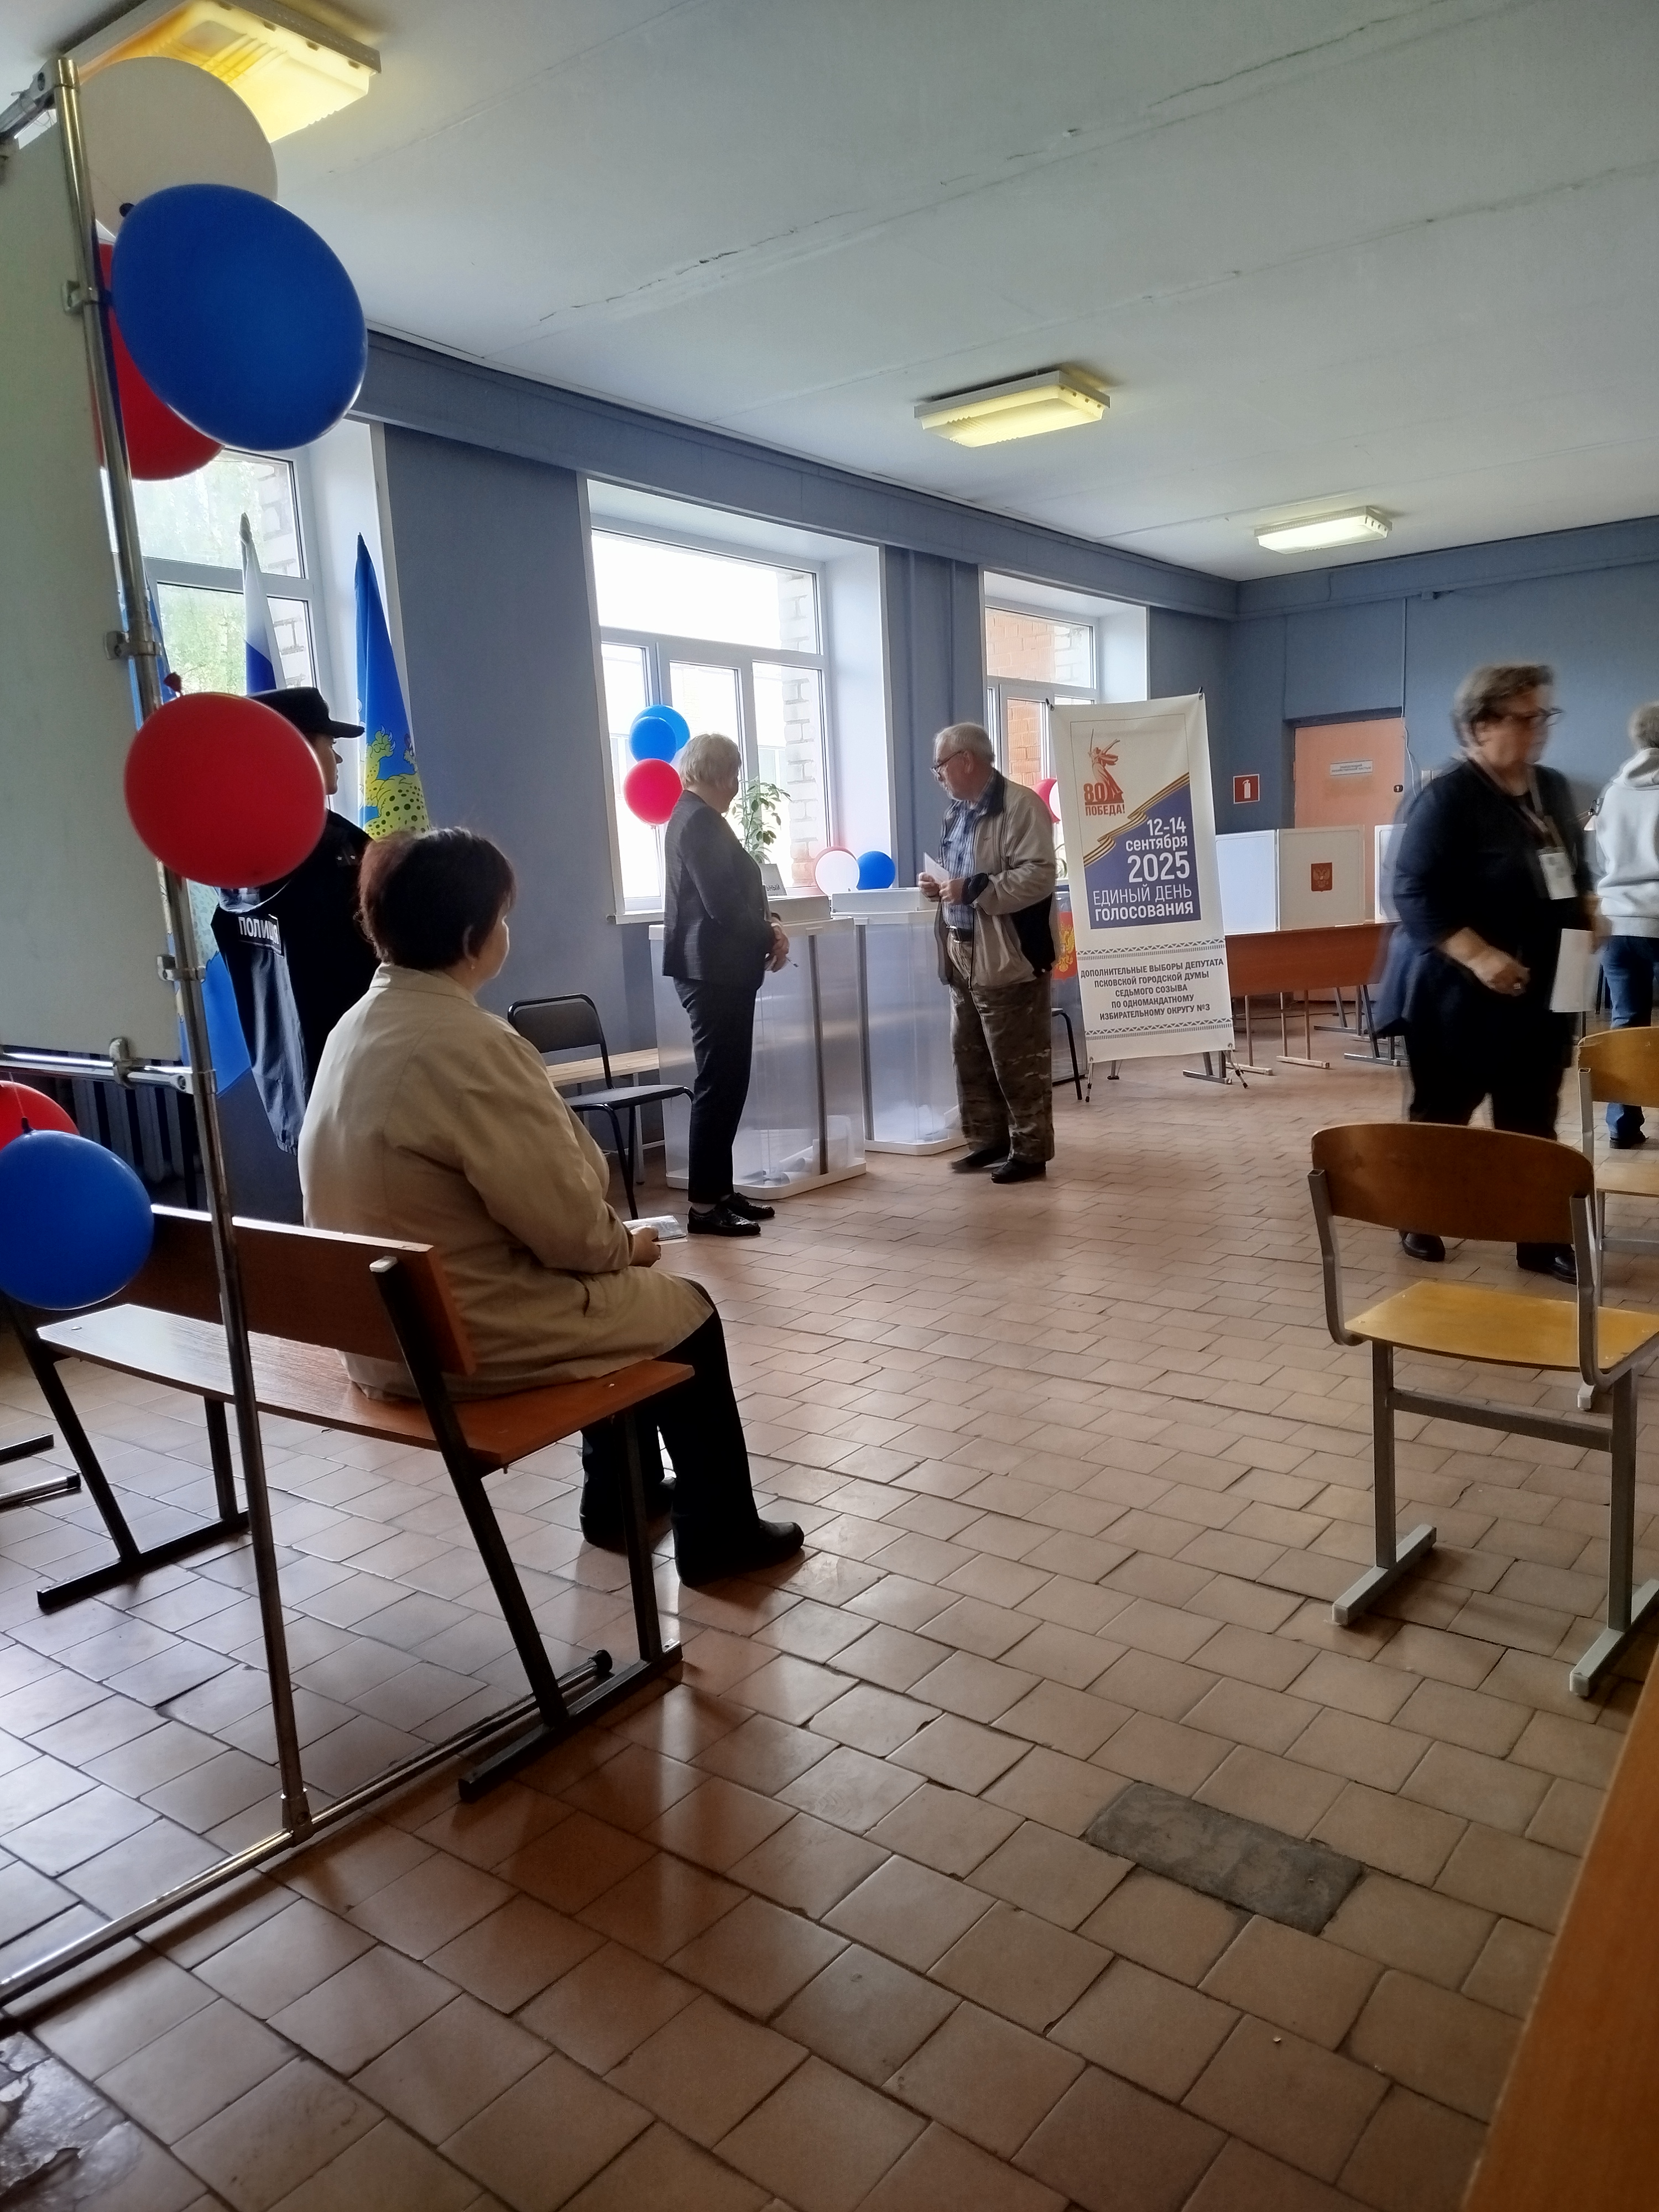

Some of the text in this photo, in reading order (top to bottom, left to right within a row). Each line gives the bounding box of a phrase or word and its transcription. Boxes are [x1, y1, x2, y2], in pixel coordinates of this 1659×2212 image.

[1083, 782, 1105, 802] 80
[1085, 804, 1125, 816] ПОБЕДА!
[1147, 816, 1187, 836] 12-14
[1125, 833, 1188, 852] сентября
[1127, 851, 1190, 883] 2025
[1093, 883, 1192, 907] ЕДИНЫЙ ДЕНЬ
[238, 916, 279, 945] ПОЛИЦЯ
[1081, 958, 1224, 979] ДОПОЛНИТЕЛЬНЫЕ ВЫБОРЫ ДЕПУТАТА
[1094, 971, 1209, 988] ПСКОВСКОЙ ГОРОДСКОЙ ДУМЫ
[1115, 984, 1188, 998] СЕДЬМОГО СОЗЫВА
[1111, 994, 1194, 1009] ПО ОДНОМАНДАТНОМУ
[1099, 1003, 1211, 1021] ИЗБИРАТЕЛЬНОМУ ОКРУГУ №3
